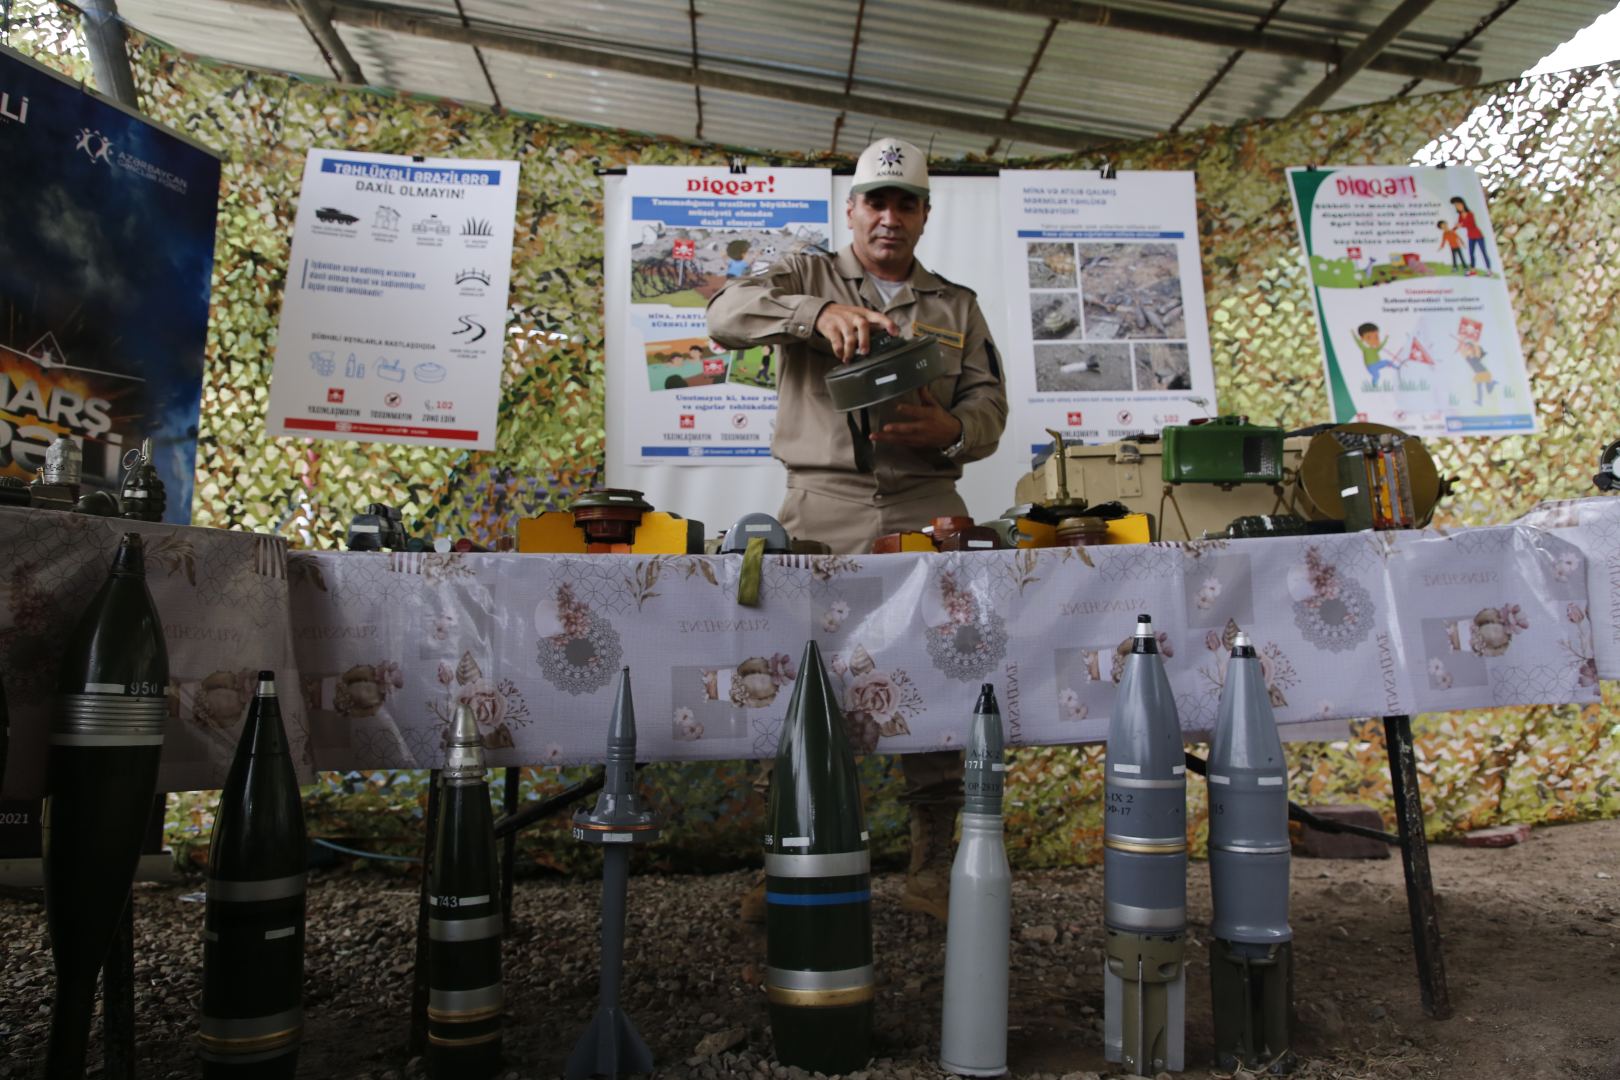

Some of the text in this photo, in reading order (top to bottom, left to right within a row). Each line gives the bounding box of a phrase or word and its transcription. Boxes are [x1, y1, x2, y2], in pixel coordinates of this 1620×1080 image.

[333, 161, 488, 185] TƏHLÜKƏLİ ƏRAZİLƏRƏ
[355, 179, 465, 200] DAXİL OLMAYIN!
[687, 175, 775, 195] DİQQƏT!
[1336, 175, 1417, 199] DİQQƏT!
[436, 401, 454, 410] 102
[129, 681, 158, 696] 950
[0, 812, 29, 825] 2021
[438, 895, 458, 908] 743
